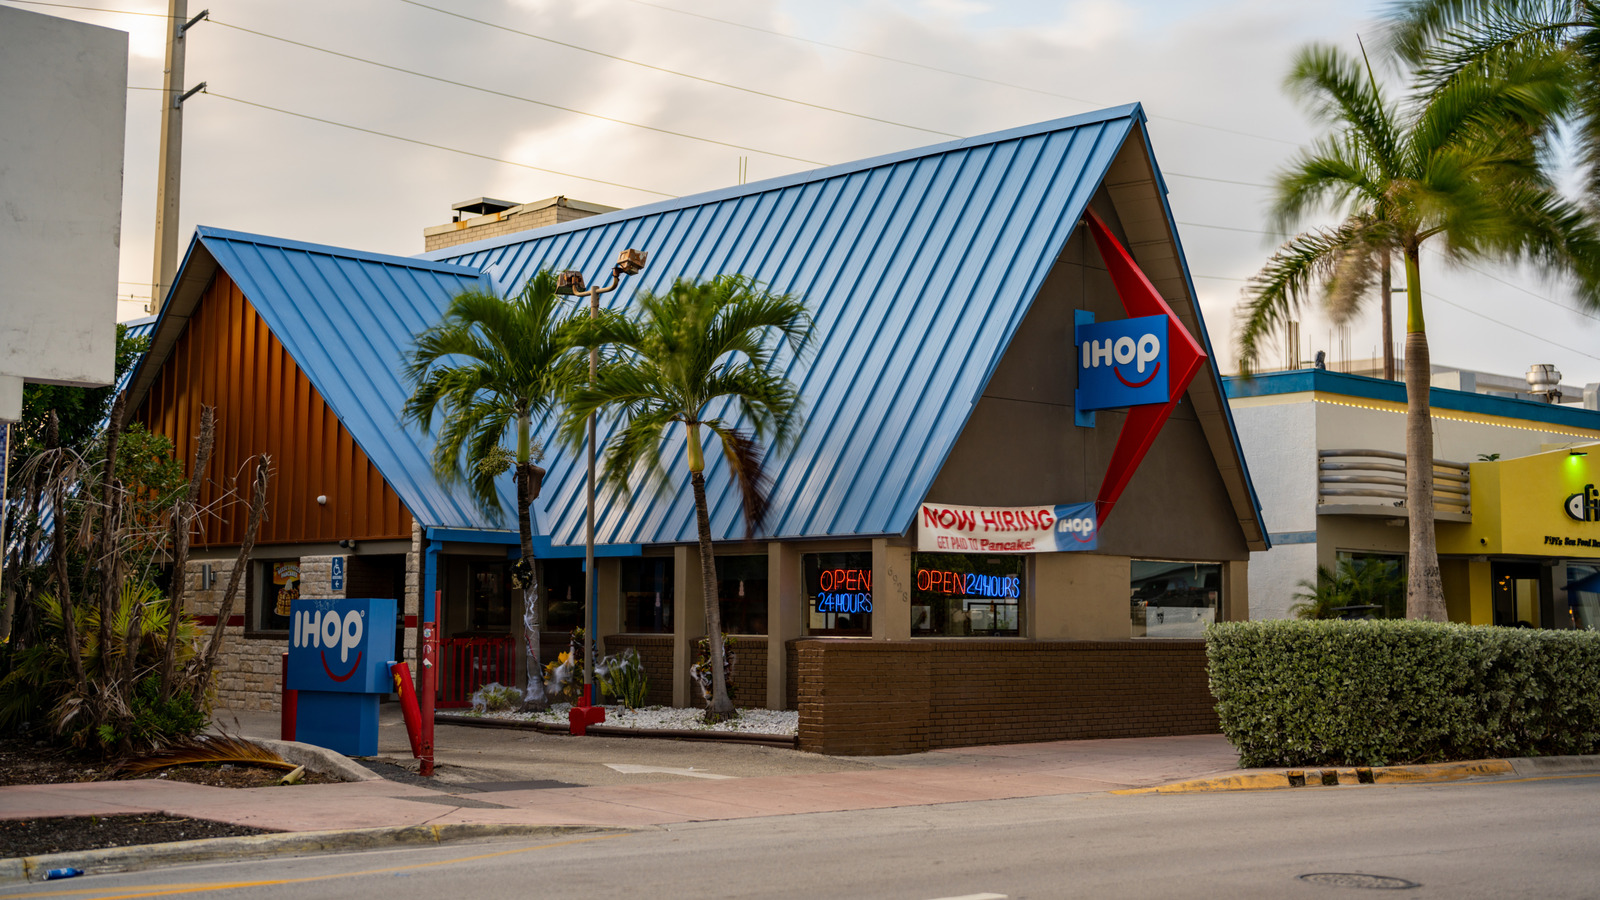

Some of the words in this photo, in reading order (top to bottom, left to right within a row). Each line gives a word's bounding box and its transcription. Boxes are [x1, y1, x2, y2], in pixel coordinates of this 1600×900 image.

[1082, 333, 1160, 374] IHOP
[922, 505, 976, 532] NOW
[980, 509, 1054, 532] HIRING
[1057, 517, 1094, 537] IHOP
[937, 535, 950, 549] GET
[951, 536, 967, 550] PAID
[967, 538, 979, 551] TO
[1577, 538, 1591, 546] Food
[820, 569, 872, 592] OPEN
[917, 569, 967, 595] OPEN
